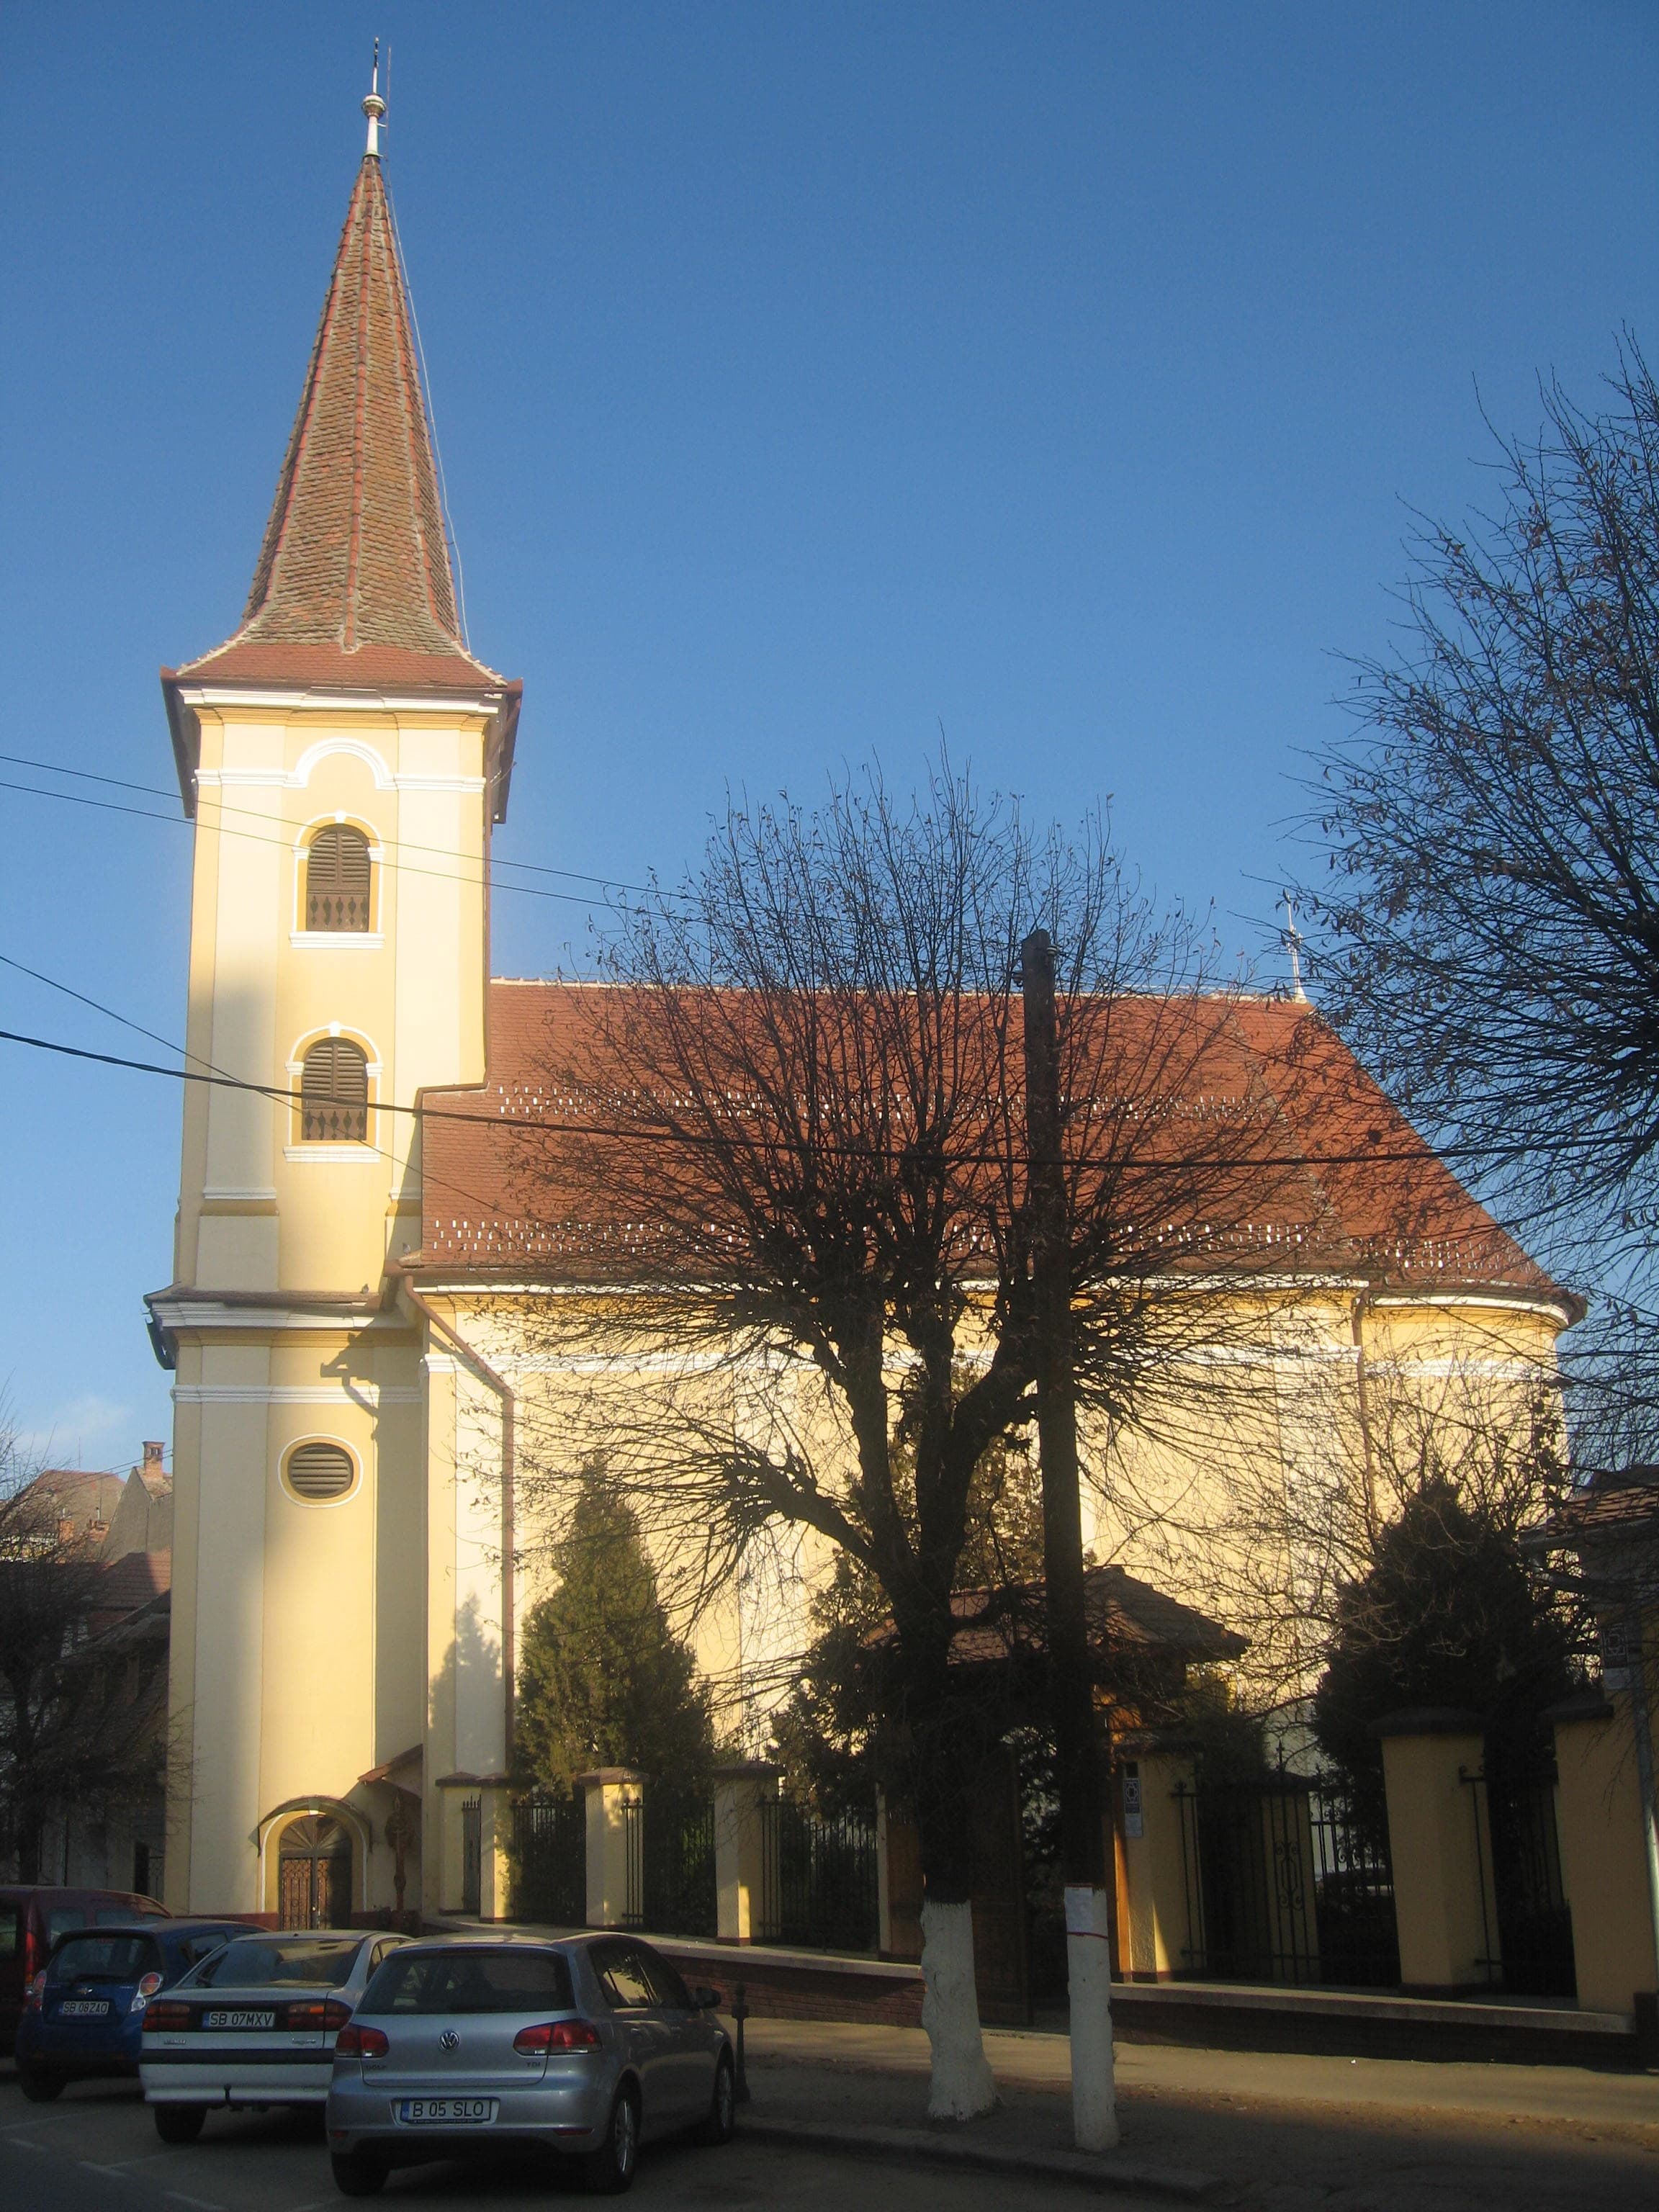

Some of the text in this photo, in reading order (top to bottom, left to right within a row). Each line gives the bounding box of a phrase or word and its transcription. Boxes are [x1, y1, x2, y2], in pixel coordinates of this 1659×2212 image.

[64, 2002, 76, 2013] SB
[210, 2013, 272, 2026] SB 07MXV
[413, 2101, 484, 2117] B 05 SLO
